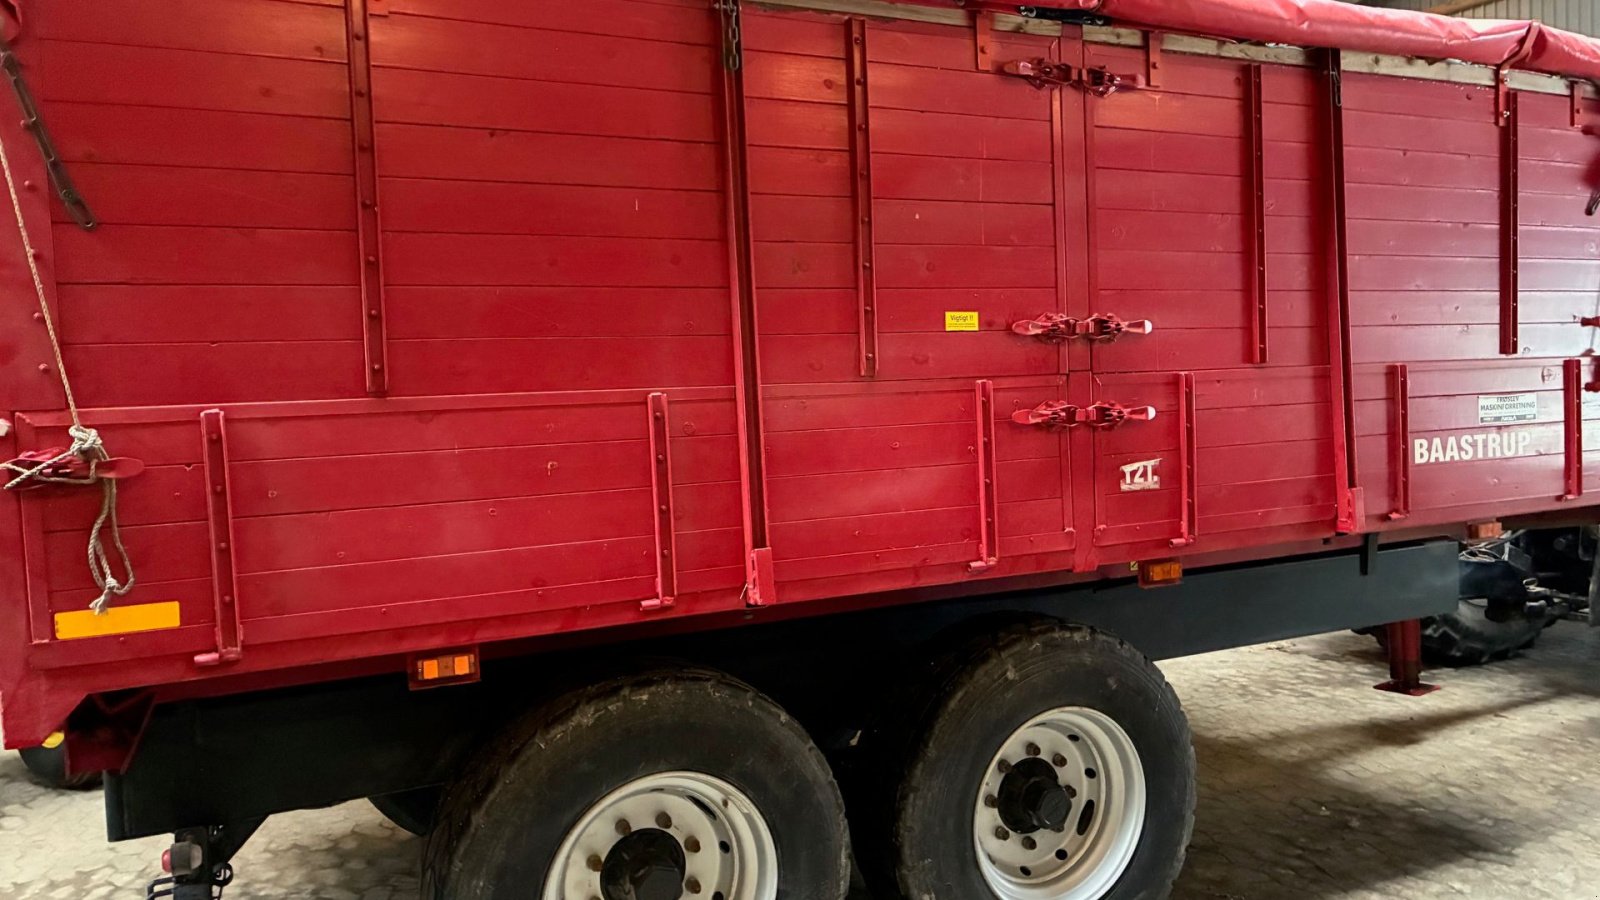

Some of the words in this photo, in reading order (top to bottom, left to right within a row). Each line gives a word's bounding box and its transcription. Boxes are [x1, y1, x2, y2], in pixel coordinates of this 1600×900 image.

[950, 314, 968, 322] Vigtigt
[1480, 402, 1535, 411] MASKINFORRETNING
[1414, 431, 1531, 464] BAASTRUP
